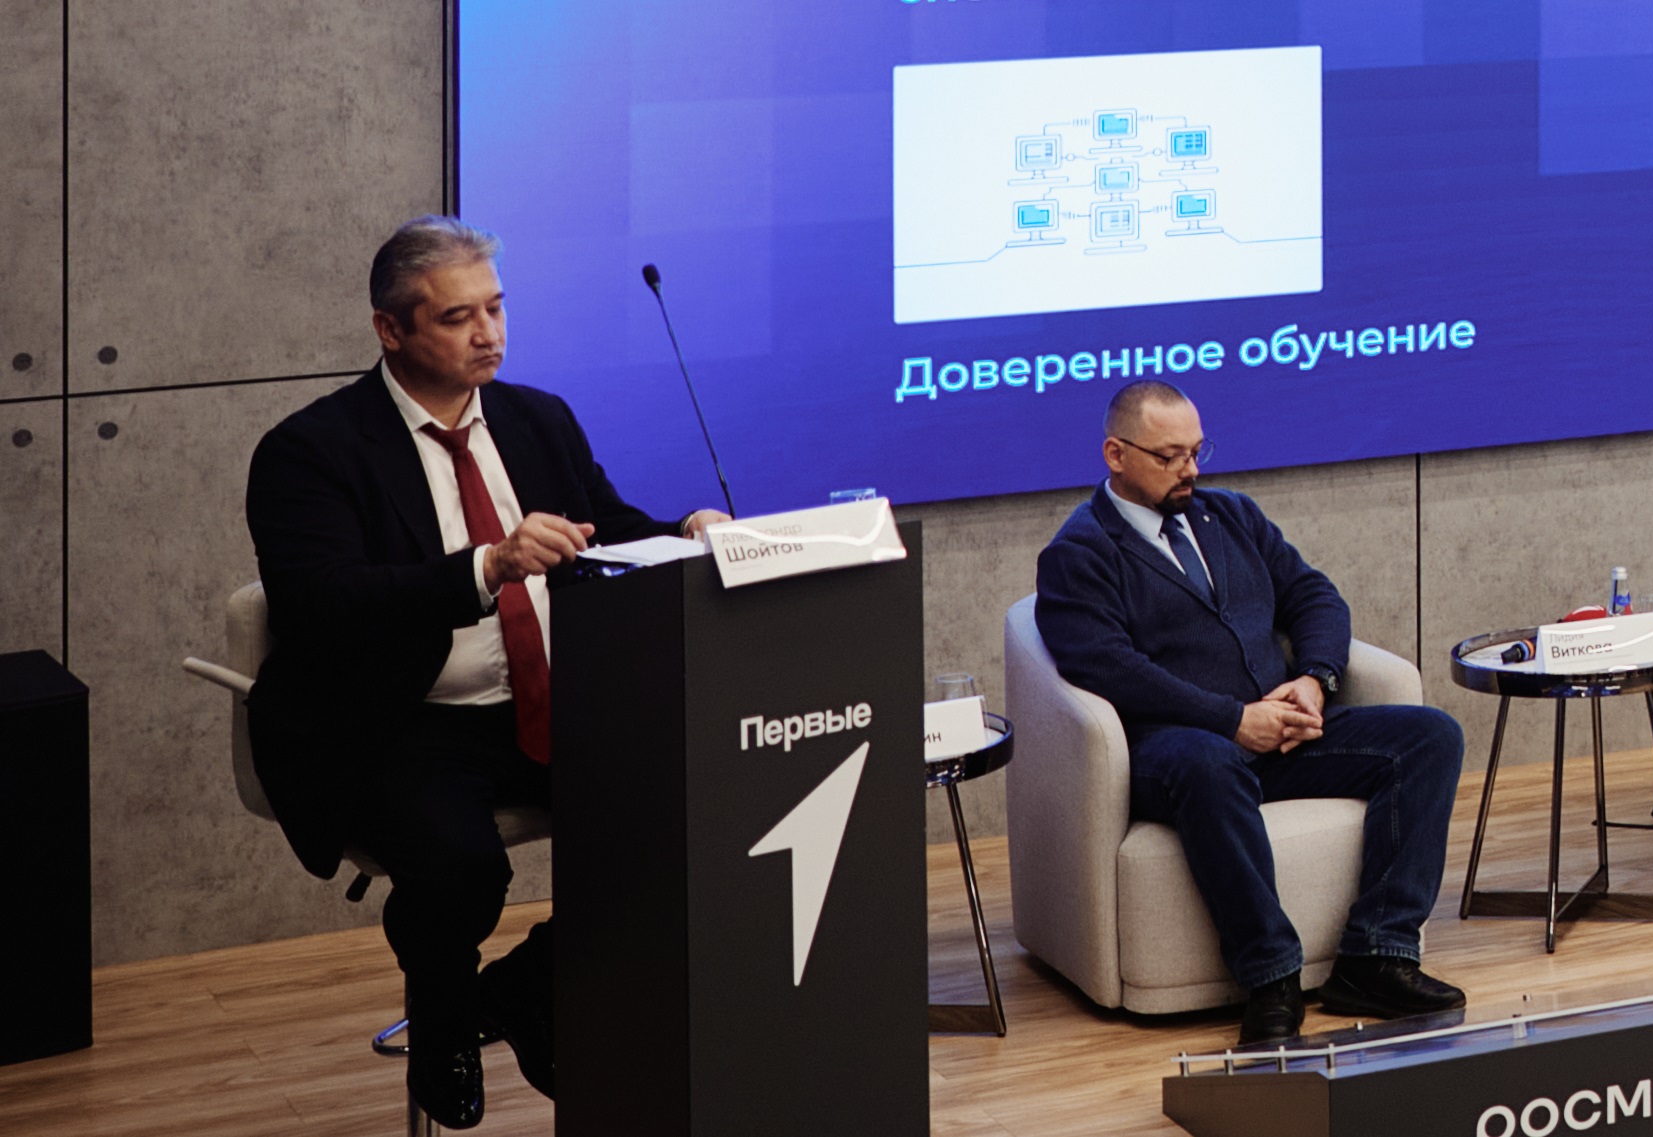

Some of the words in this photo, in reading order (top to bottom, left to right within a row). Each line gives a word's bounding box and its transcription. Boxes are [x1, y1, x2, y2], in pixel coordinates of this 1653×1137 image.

[895, 339, 1225, 402] Доверенное
[1238, 319, 1476, 370] обучение
[725, 541, 804, 563] Шойтов
[740, 702, 872, 752] Первые
